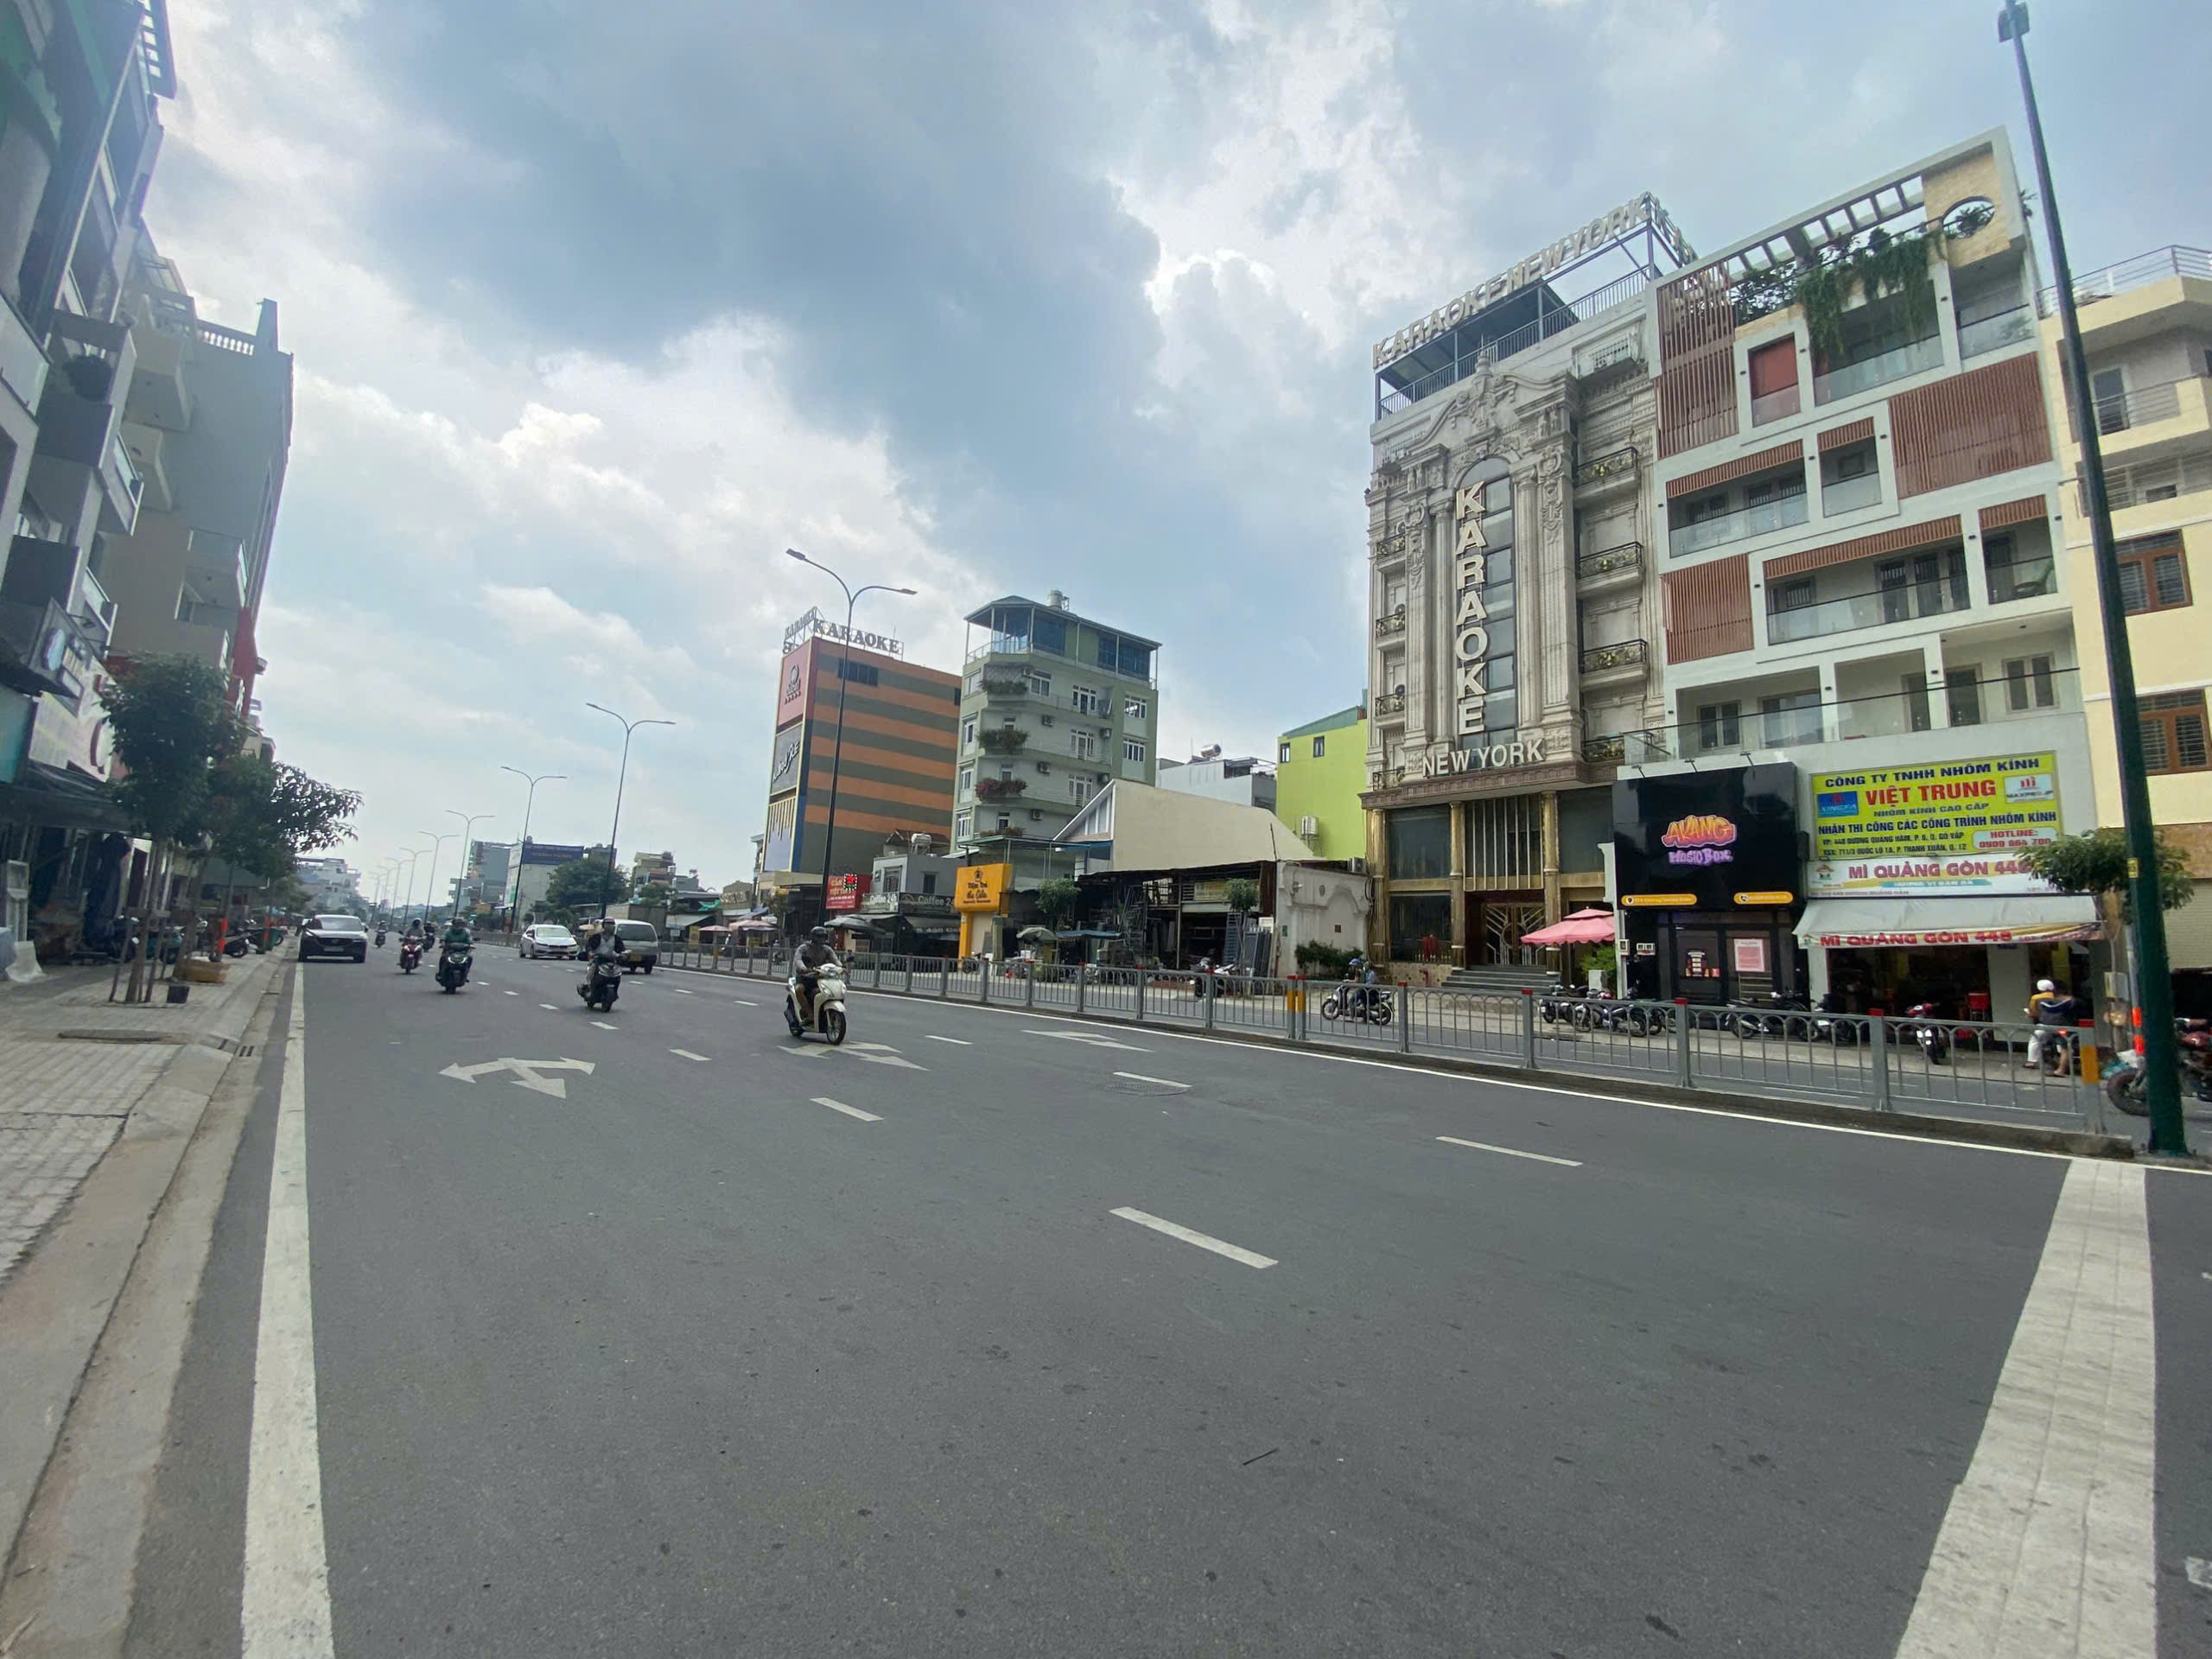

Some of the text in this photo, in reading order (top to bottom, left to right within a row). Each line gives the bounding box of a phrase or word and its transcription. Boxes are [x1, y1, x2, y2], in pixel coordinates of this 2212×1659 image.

[1372, 272, 1504, 369] KARAOKE
[1506, 238, 1565, 291] NEW
[1567, 194, 1651, 257] YORK
[1455, 480, 1489, 734] KARAOKE
[814, 618, 899, 654] KARAOKE
[1422, 738, 1545, 778] NEW YORK
[1825, 775, 1866, 788] CÔNG
[1872, 773, 1888, 784] TY
[1893, 768, 1935, 781] TNHH
[1997, 758, 2039, 772] KÍNH
[1866, 779, 1996, 807] VIỆT TRUNG
[1940, 804, 1961, 813] CAO
[1848, 823, 1863, 833] THI
[1990, 829, 2038, 839] HOTLINE:
[1848, 864, 1868, 879] MÌ
[1873, 861, 1941, 879] QUẢNG
[1946, 860, 1988, 876] GÒN
[918, 895, 944, 906] Coffee
[1820, 934, 1840, 947] MÌ
[1846, 931, 1917, 945] QUẢNG
[1923, 931, 1969, 944] GÒN
